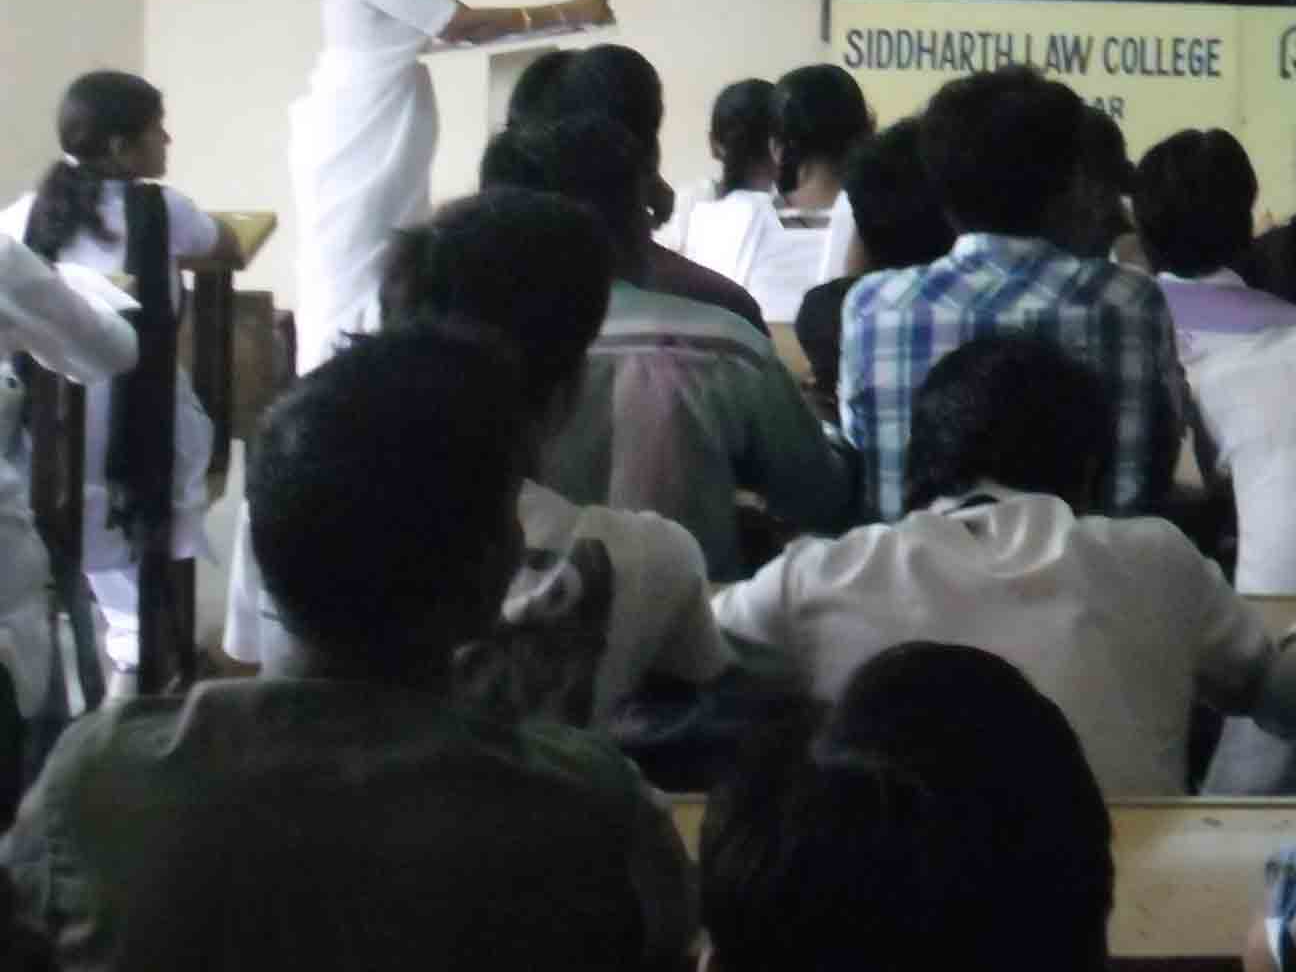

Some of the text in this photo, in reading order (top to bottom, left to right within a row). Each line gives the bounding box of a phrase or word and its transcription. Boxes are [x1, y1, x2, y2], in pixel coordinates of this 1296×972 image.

[843, 28, 1225, 79] SIDDHARTH LAW COLLEGE
